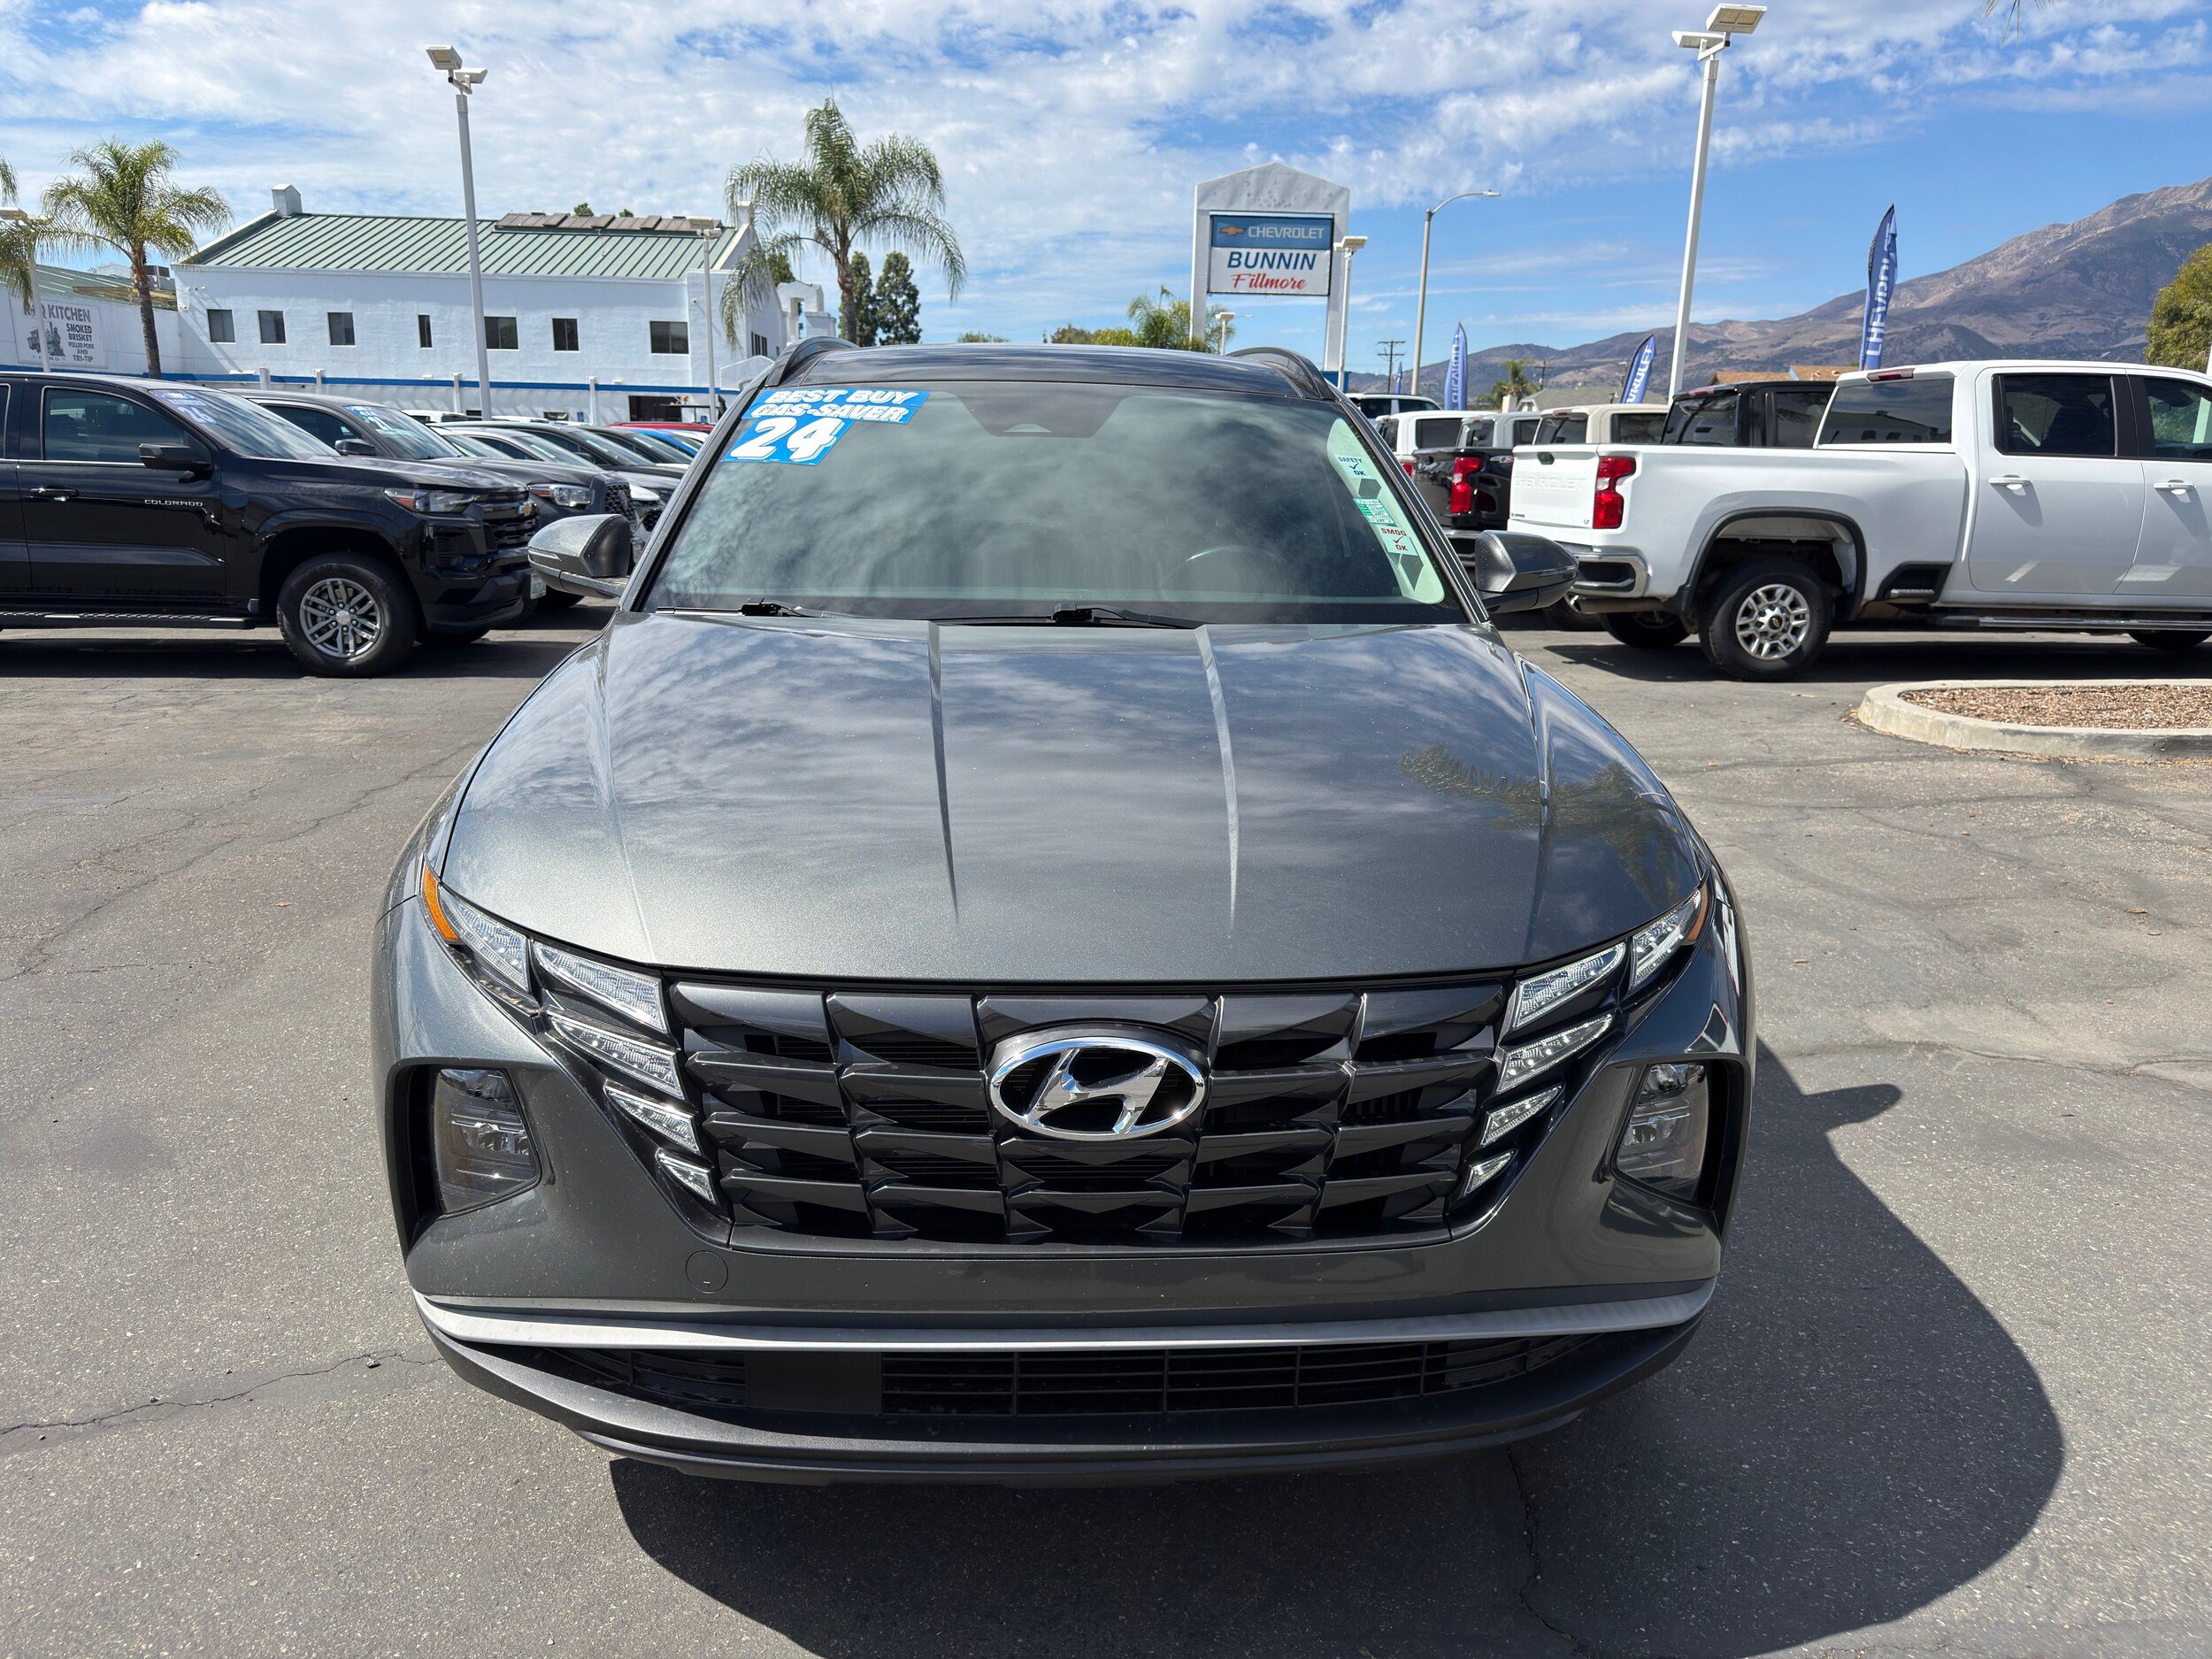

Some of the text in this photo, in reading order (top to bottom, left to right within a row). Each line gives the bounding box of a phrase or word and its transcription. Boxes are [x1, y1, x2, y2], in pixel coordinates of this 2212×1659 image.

[1248, 226, 1325, 239] CHEVROLET
[1227, 251, 1317, 271] BUNNIN
[1231, 273, 1307, 289] Fillmore
[48, 304, 91, 322] KITCHEN
[66, 323, 92, 334] SMOKED
[68, 333, 92, 342] BRISKET
[73, 354, 93, 363] TRI-TIP
[764, 389, 919, 404] BEST BUY
[750, 403, 910, 422] GAS-SAVER
[730, 417, 846, 462] 24
[1381, 527, 1407, 536] SMOG
